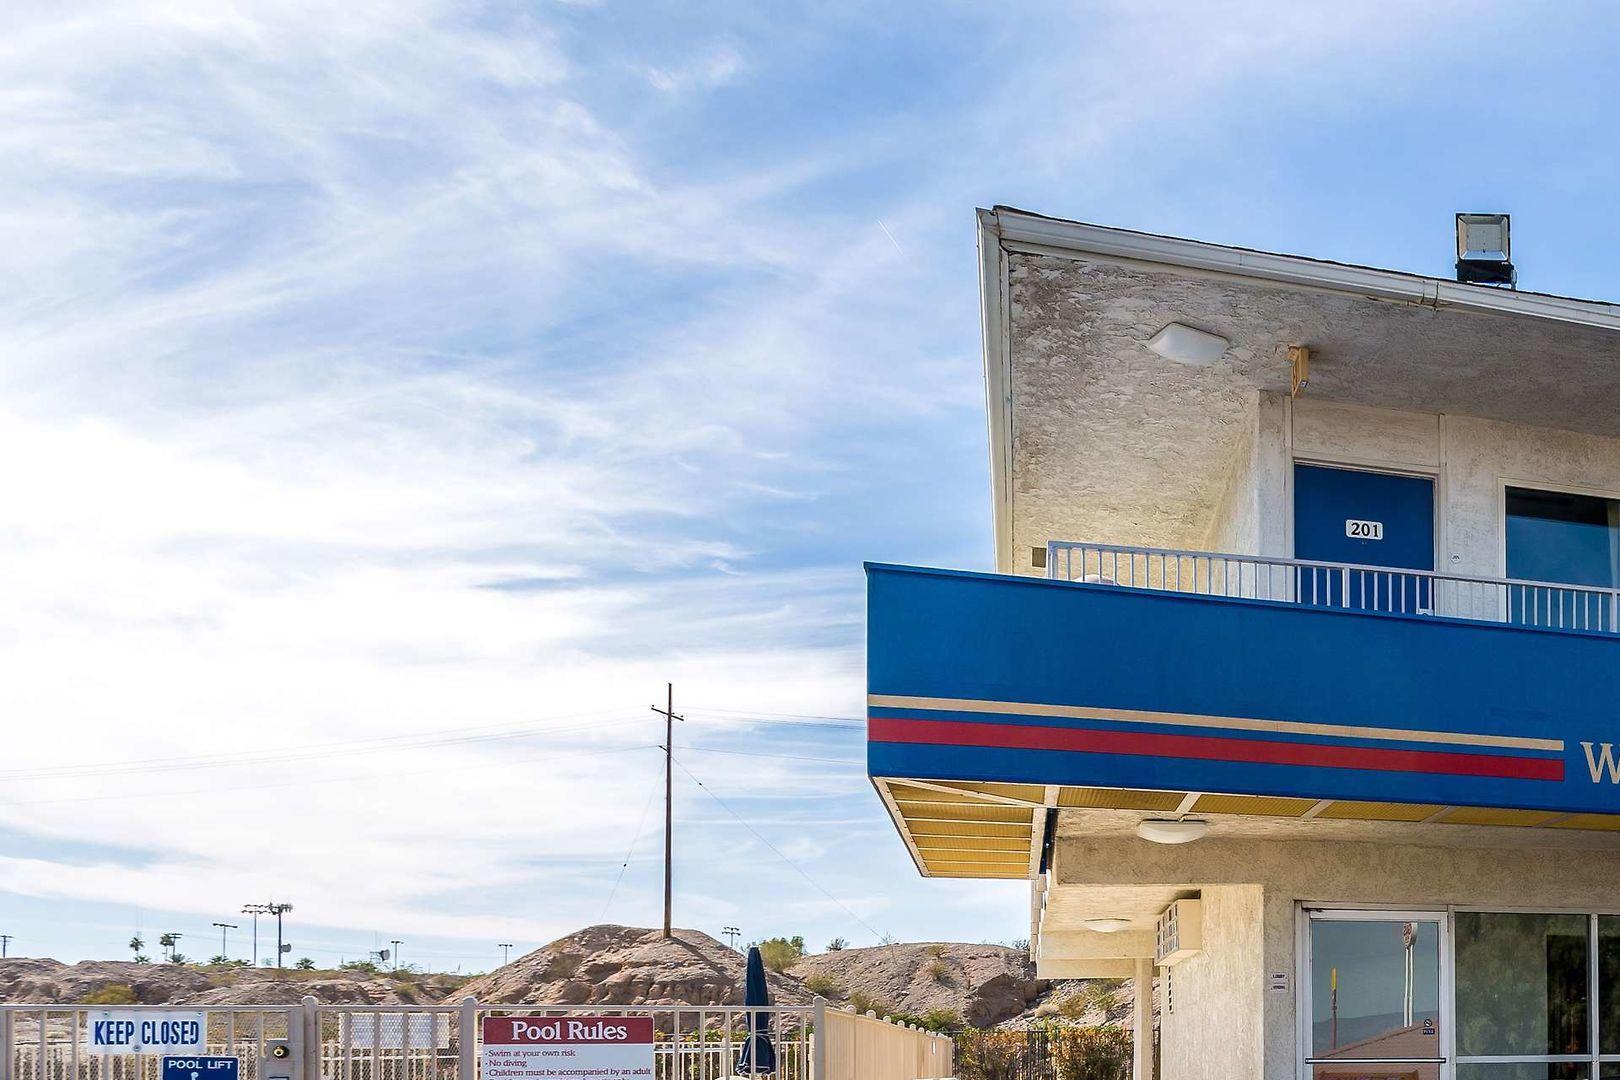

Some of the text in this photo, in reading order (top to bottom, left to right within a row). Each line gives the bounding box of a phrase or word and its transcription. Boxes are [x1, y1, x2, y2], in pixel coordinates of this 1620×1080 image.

[1351, 522, 1379, 537] 201
[94, 1020, 200, 1045] KEEP CLOSED
[511, 1021, 628, 1041] Pool Rules
[522, 1051, 541, 1059] your
[561, 1049, 576, 1057] risk
[168, 1060, 233, 1070] POOL LIFT
[503, 1059, 527, 1068] diving
[489, 1069, 524, 1077] Children
[546, 1068, 557, 1076] be
[557, 1068, 608, 1077] accompanied
[610, 1067, 620, 1077] by
[632, 1067, 651, 1075] adult
